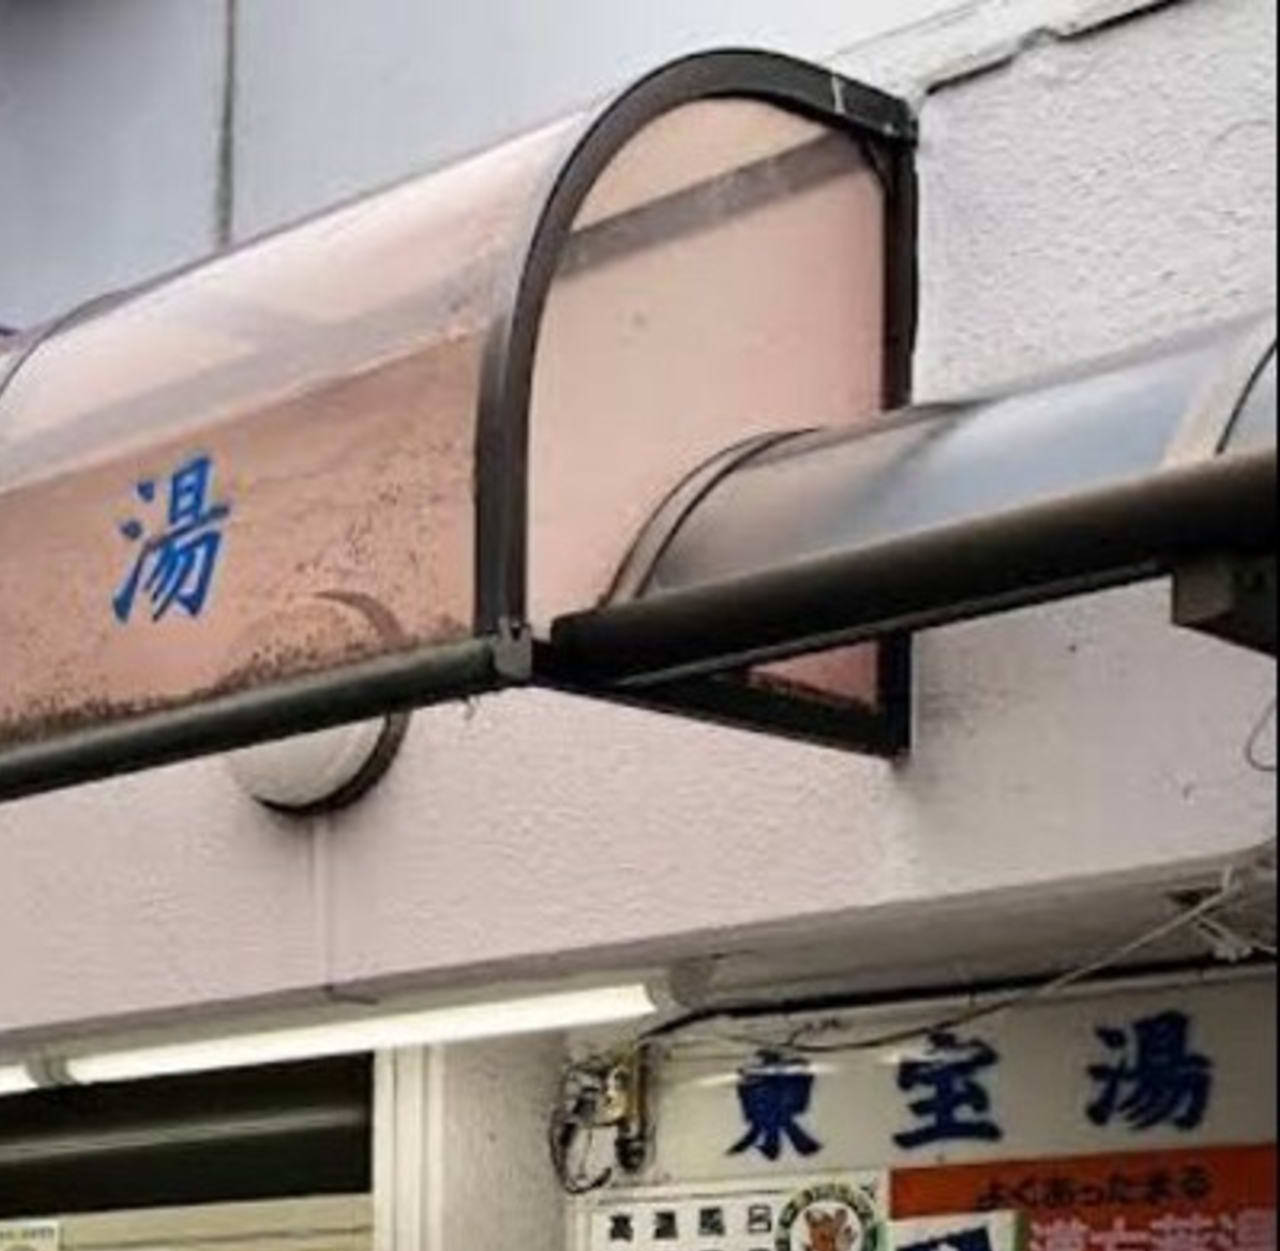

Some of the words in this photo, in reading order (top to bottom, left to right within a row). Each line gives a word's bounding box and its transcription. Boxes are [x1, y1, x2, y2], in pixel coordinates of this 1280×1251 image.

[726, 1010, 1216, 1160] 東宝湯
[608, 1204, 773, 1243] 高温風呂
